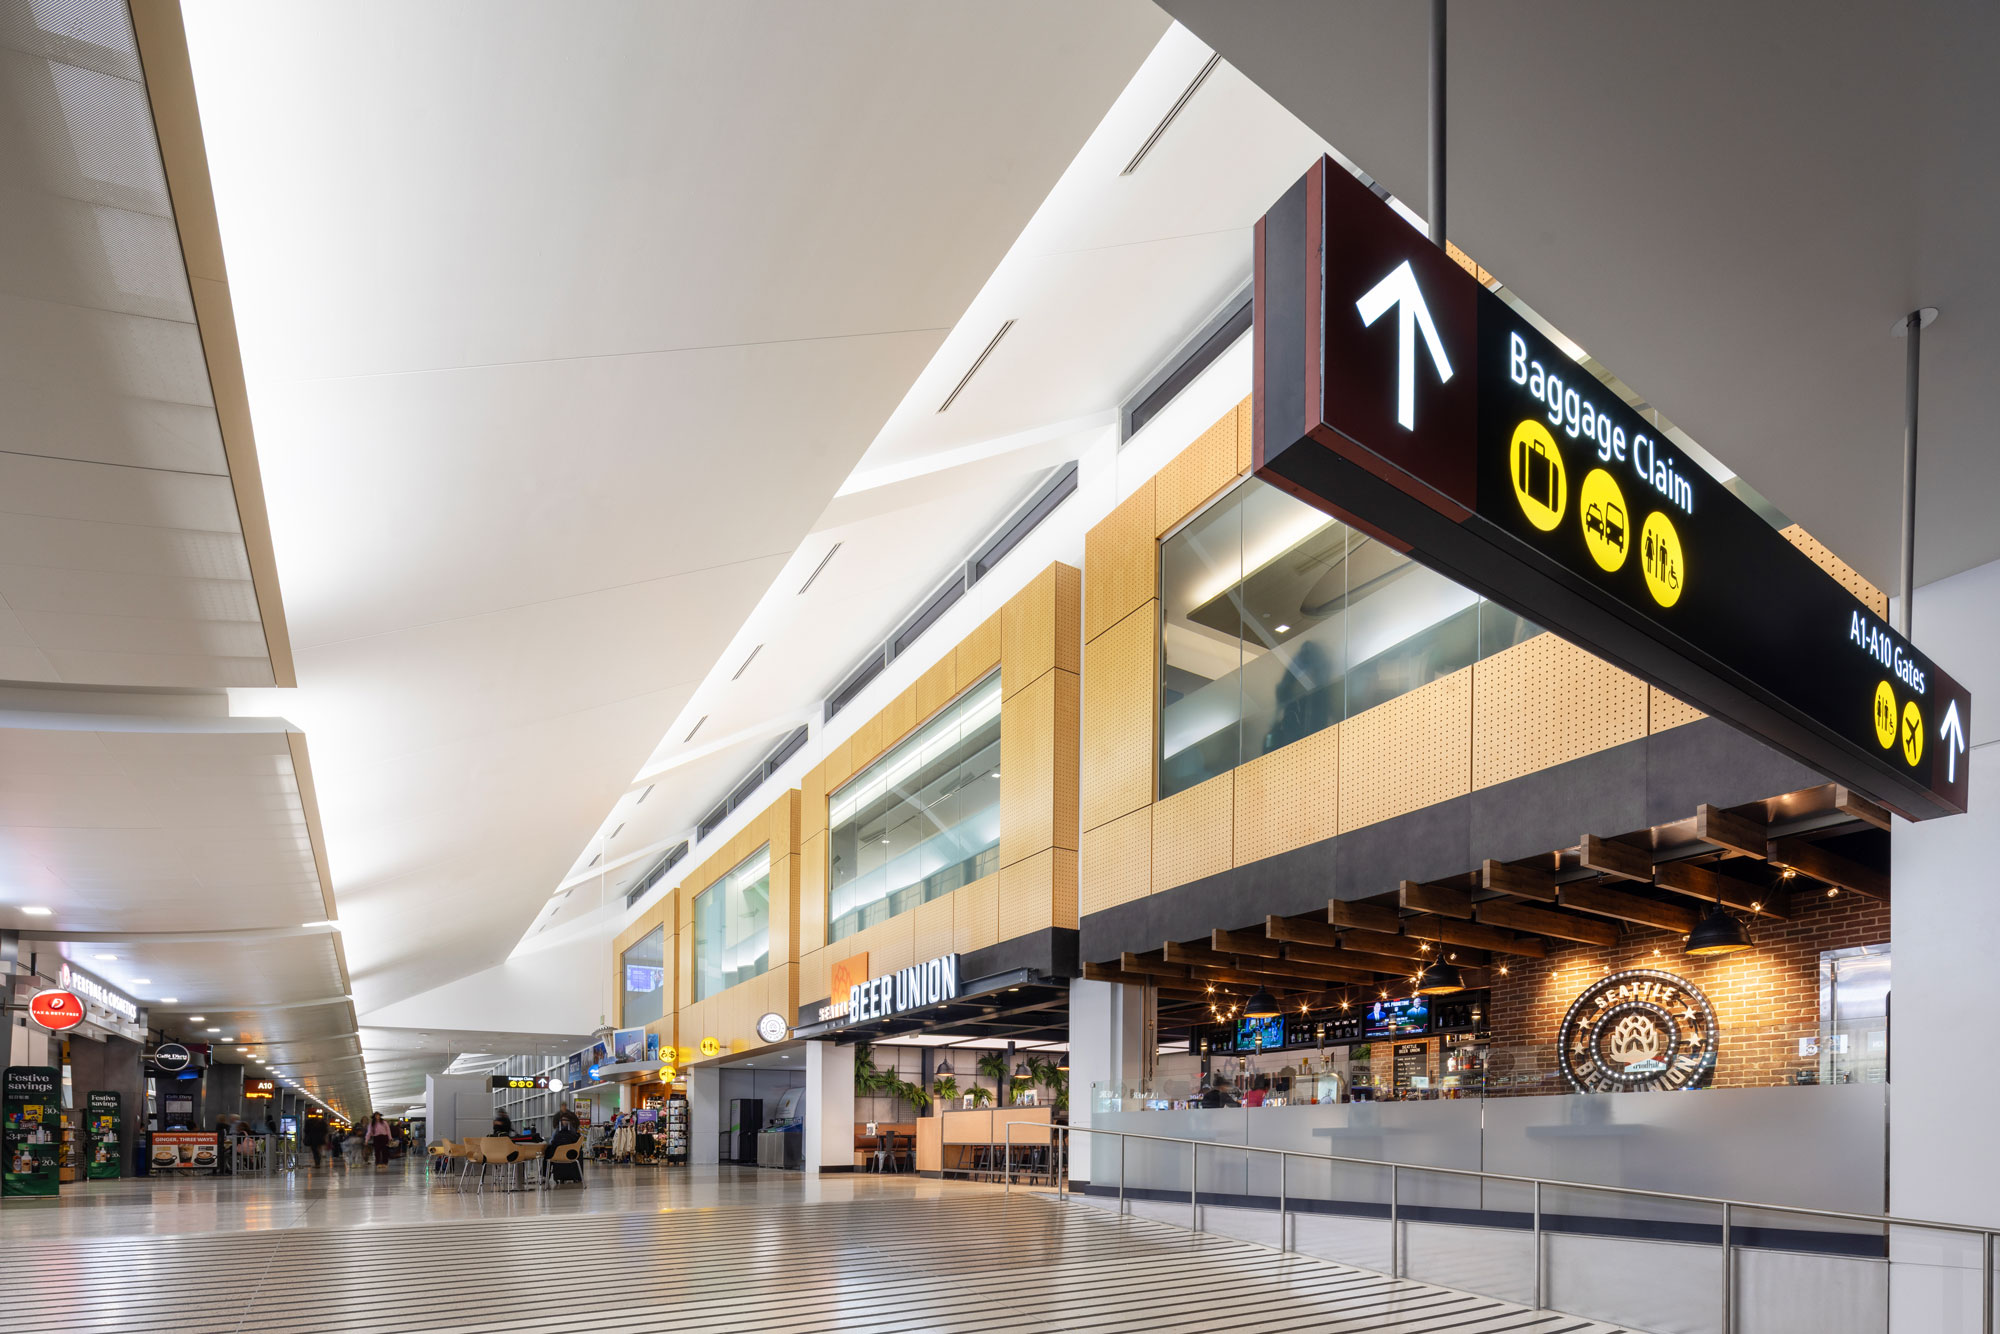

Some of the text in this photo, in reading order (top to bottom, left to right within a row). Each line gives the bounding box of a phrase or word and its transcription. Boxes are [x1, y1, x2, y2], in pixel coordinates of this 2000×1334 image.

[1510, 331, 1692, 514] Baggage Claim
[1850, 610, 1925, 694] A1-A10 Gates
[72, 972, 103, 1001] PERFUME
[108, 992, 136, 1019] COSMETICS
[850, 952, 958, 1024] BEER UNION
[1594, 981, 1678, 1009] SEATTLE
[8, 1073, 50, 1082] Festive
[8, 1082, 53, 1092] savings
